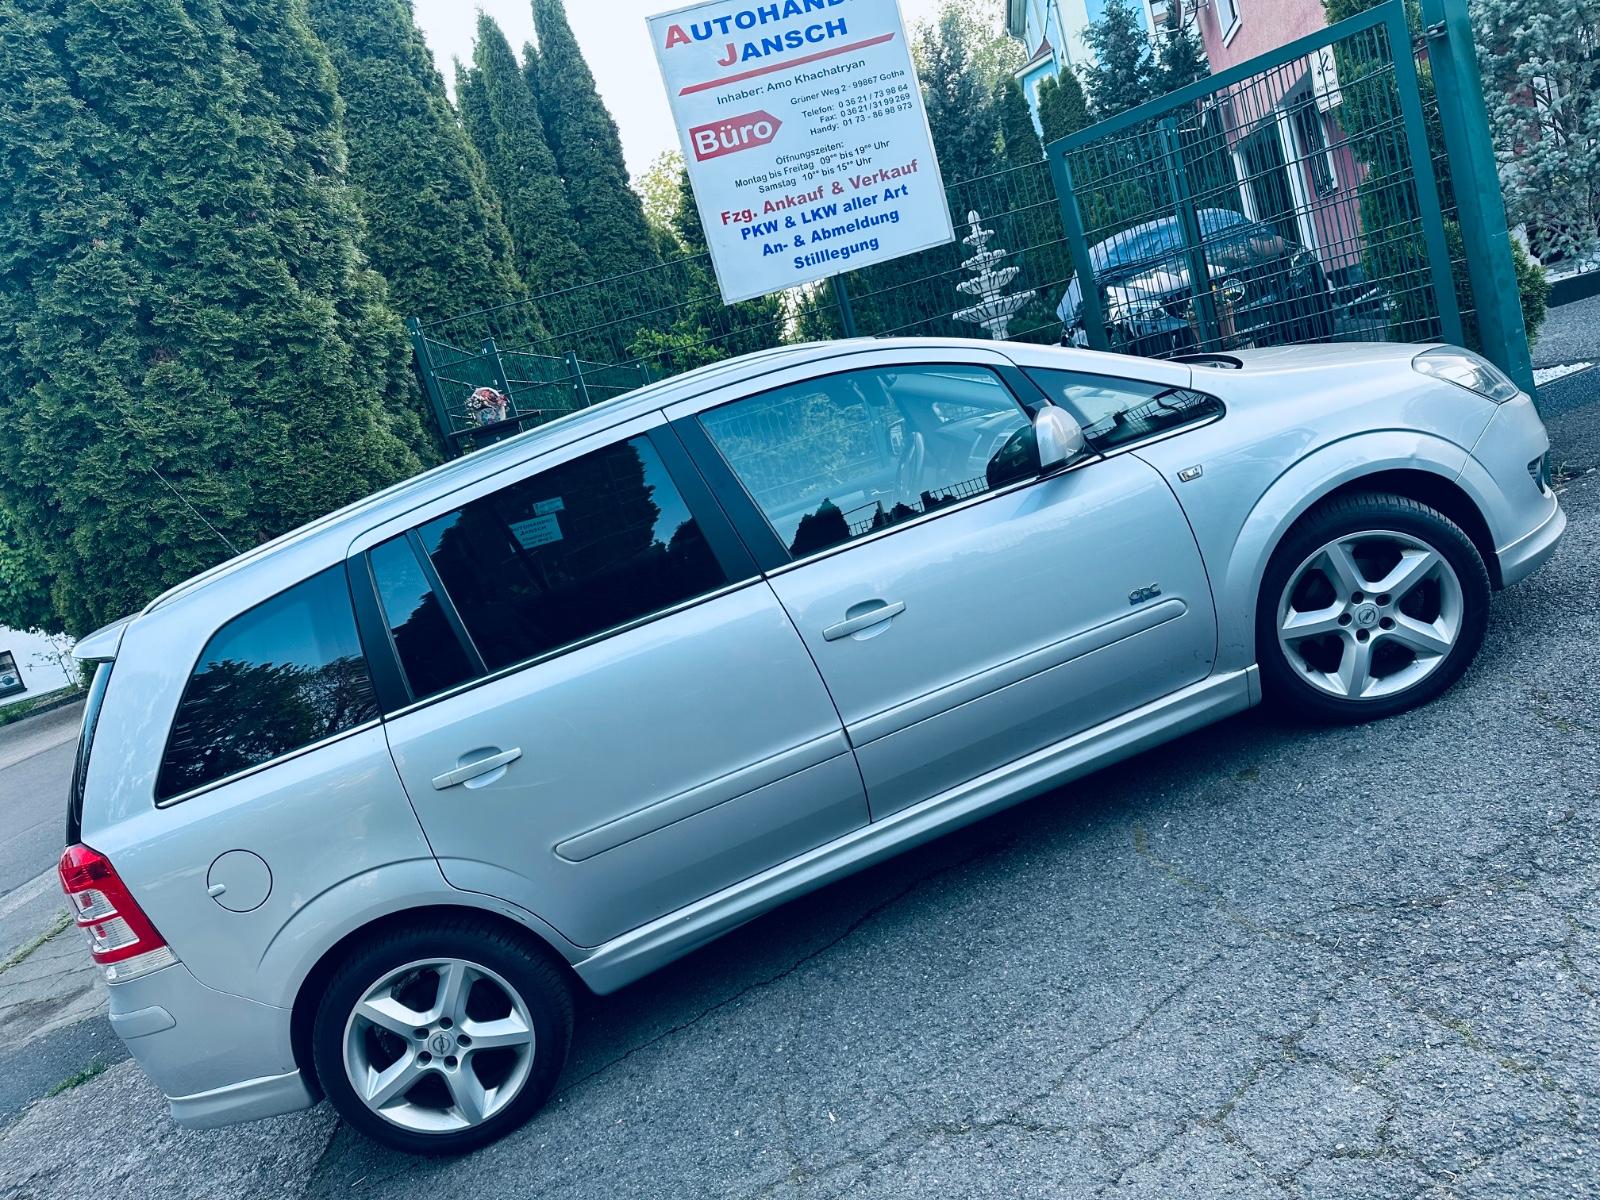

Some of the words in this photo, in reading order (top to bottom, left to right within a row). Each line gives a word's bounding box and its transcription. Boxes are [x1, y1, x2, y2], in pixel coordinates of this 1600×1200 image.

[717, 17, 848, 66] JANSCH
[716, 86, 764, 105] Inhaber:
[767, 79, 792, 92] Amo
[794, 60, 865, 84] Khachatryan
[790, 93, 819, 105] Grüner
[820, 87, 840, 97] Weg
[852, 75, 877, 89] 99867
[879, 70, 905, 81] Gotha
[801, 105, 834, 118] Telefon:
[845, 97, 856, 107] 36
[857, 94, 867, 103] 21
[873, 90, 884, 99] 73
[885, 86, 896, 96] 98
[897, 83, 908, 92] 64
[695, 111, 772, 154] Büro
[809, 123, 839, 136] Handy:
[842, 118, 853, 127] 01
[854, 114, 865, 123] 73
[872, 109, 883, 119] 86
[884, 106, 896, 115] 98
[896, 101, 913, 112] 973
[819, 114, 837, 123] Fax:
[846, 107, 857, 116] 36
[857, 104, 868, 113] 21
[734, 174, 768, 188] Montag
[768, 169, 782, 179] bis
[783, 162, 815, 175] Freitag
[839, 150, 854, 160] bis
[873, 140, 890, 150] Uhr
[775, 141, 844, 165] Öffnungszeiten:
[720, 208, 758, 226] Fzg.
[763, 185, 824, 215] Ankauf
[831, 181, 845, 195] &
[848, 158, 917, 190] Verkauf
[758, 178, 797, 194] Samstag
[821, 167, 835, 176] bis
[855, 157, 872, 167] Uhr
[740, 219, 778, 240] PKW
[784, 215, 797, 229] &
[800, 203, 837, 224] LKW
[842, 194, 878, 213] aller
[883, 184, 909, 202] Art
[763, 243, 788, 257] An-
[793, 234, 806, 248] &
[811, 210, 899, 243] Abmeldung
[793, 237, 879, 269] Stilllegung
